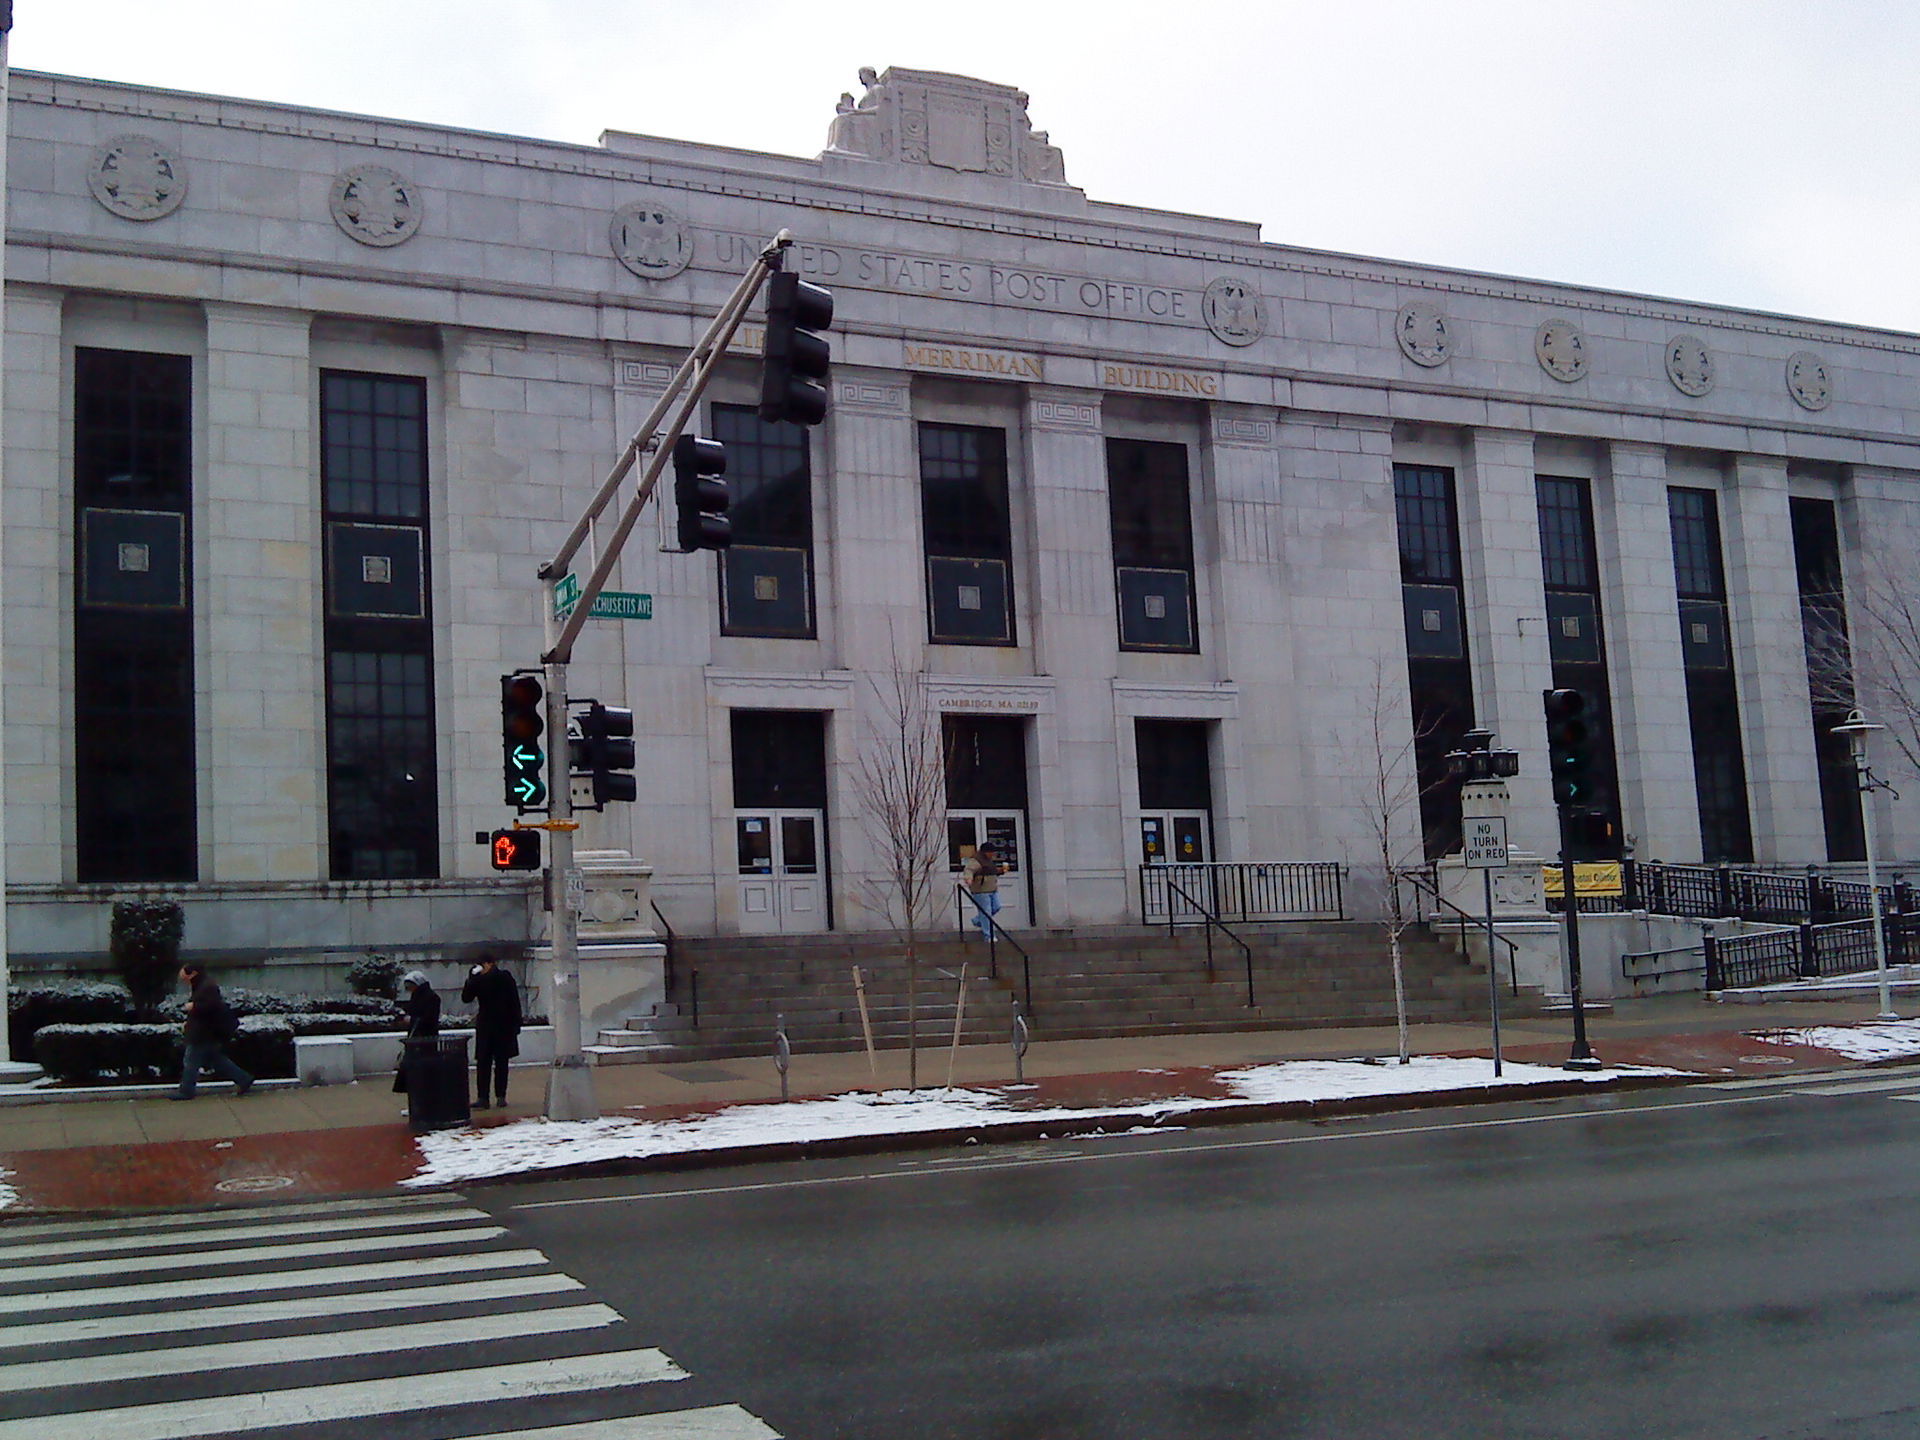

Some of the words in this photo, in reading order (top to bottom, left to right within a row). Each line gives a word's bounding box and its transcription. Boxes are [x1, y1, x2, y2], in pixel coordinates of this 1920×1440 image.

[714, 234, 842, 276] UNTED
[858, 253, 972, 292] STATES
[990, 268, 1065, 303] POST
[1079, 281, 1187, 318] OFFICE
[904, 346, 1046, 379] MERRIMAN
[1104, 365, 1217, 395] BUILDING
[592, 596, 636, 614] CHUSETTS
[637, 598, 652, 615] AVE
[1477, 824, 1491, 834] NO
[1473, 836, 1498, 847] TURN
[1468, 849, 1481, 860] ON
[1486, 848, 1505, 859] RED
